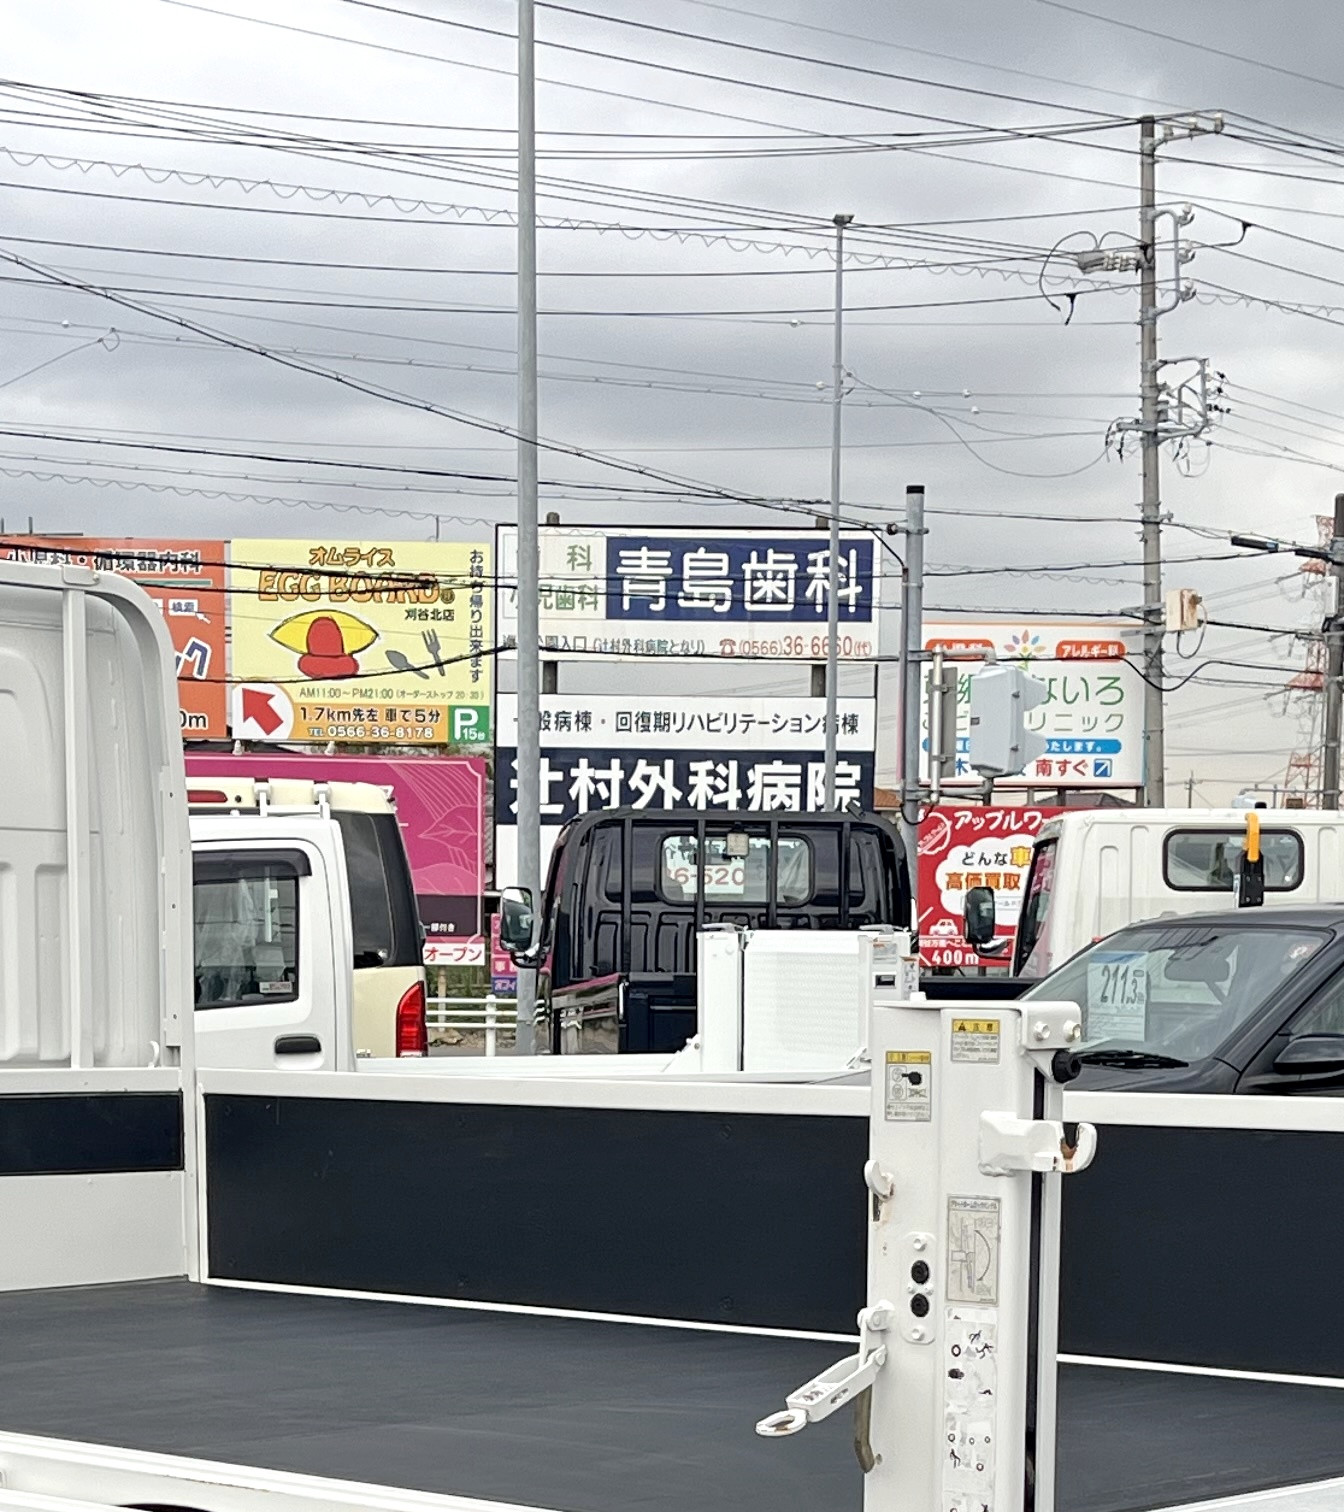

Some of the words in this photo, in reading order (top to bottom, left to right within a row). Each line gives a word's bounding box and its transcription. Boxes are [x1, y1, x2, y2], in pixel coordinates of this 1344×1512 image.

[309, 546, 396, 567] オムライス
[258, 569, 321, 601] EGG
[616, 546, 862, 612] 青島歯科
[405, 608, 455, 621] 刈谷北店
[946, 872, 1020, 890] 高価買取
[424, 947, 482, 962] オープン
